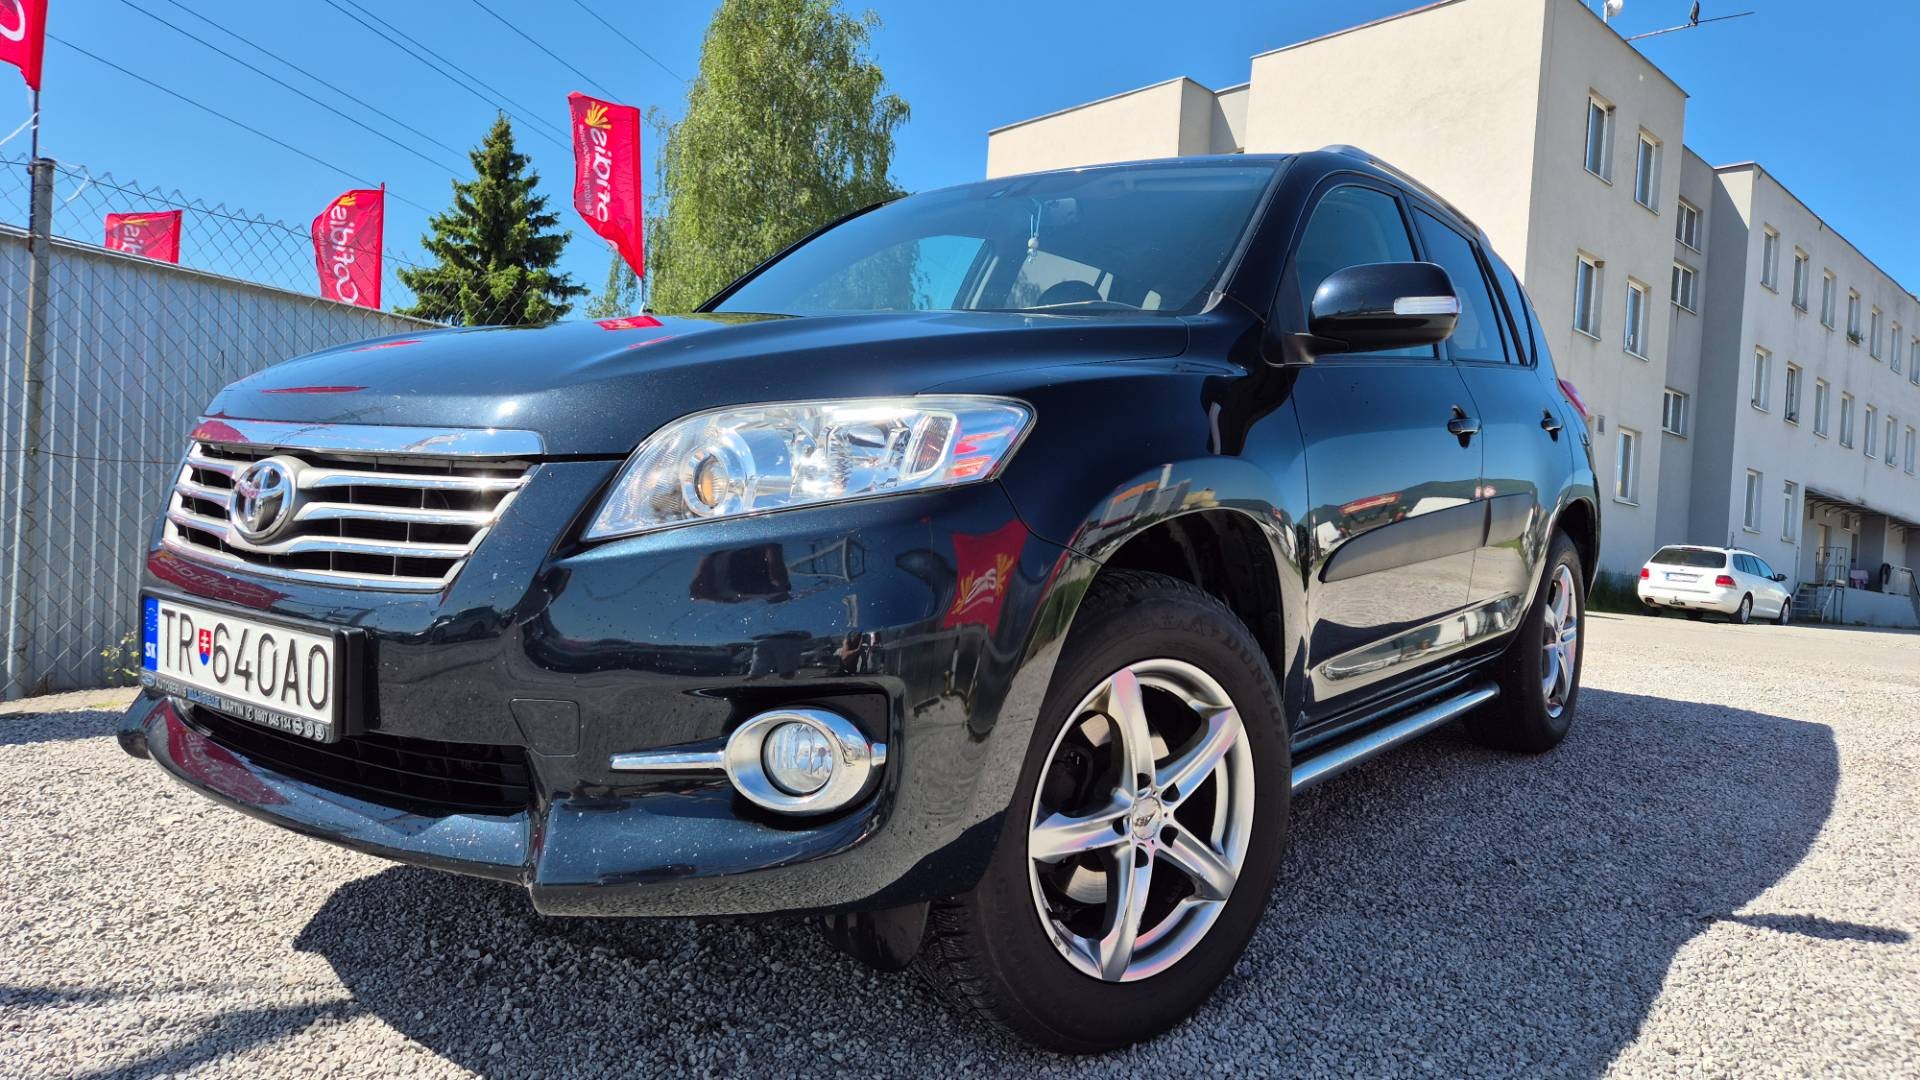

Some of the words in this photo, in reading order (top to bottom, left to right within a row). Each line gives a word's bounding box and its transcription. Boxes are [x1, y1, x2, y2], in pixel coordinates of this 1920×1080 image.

[145, 642, 157, 659] SK
[161, 607, 195, 676] TR
[221, 696, 244, 716] MARTIN
